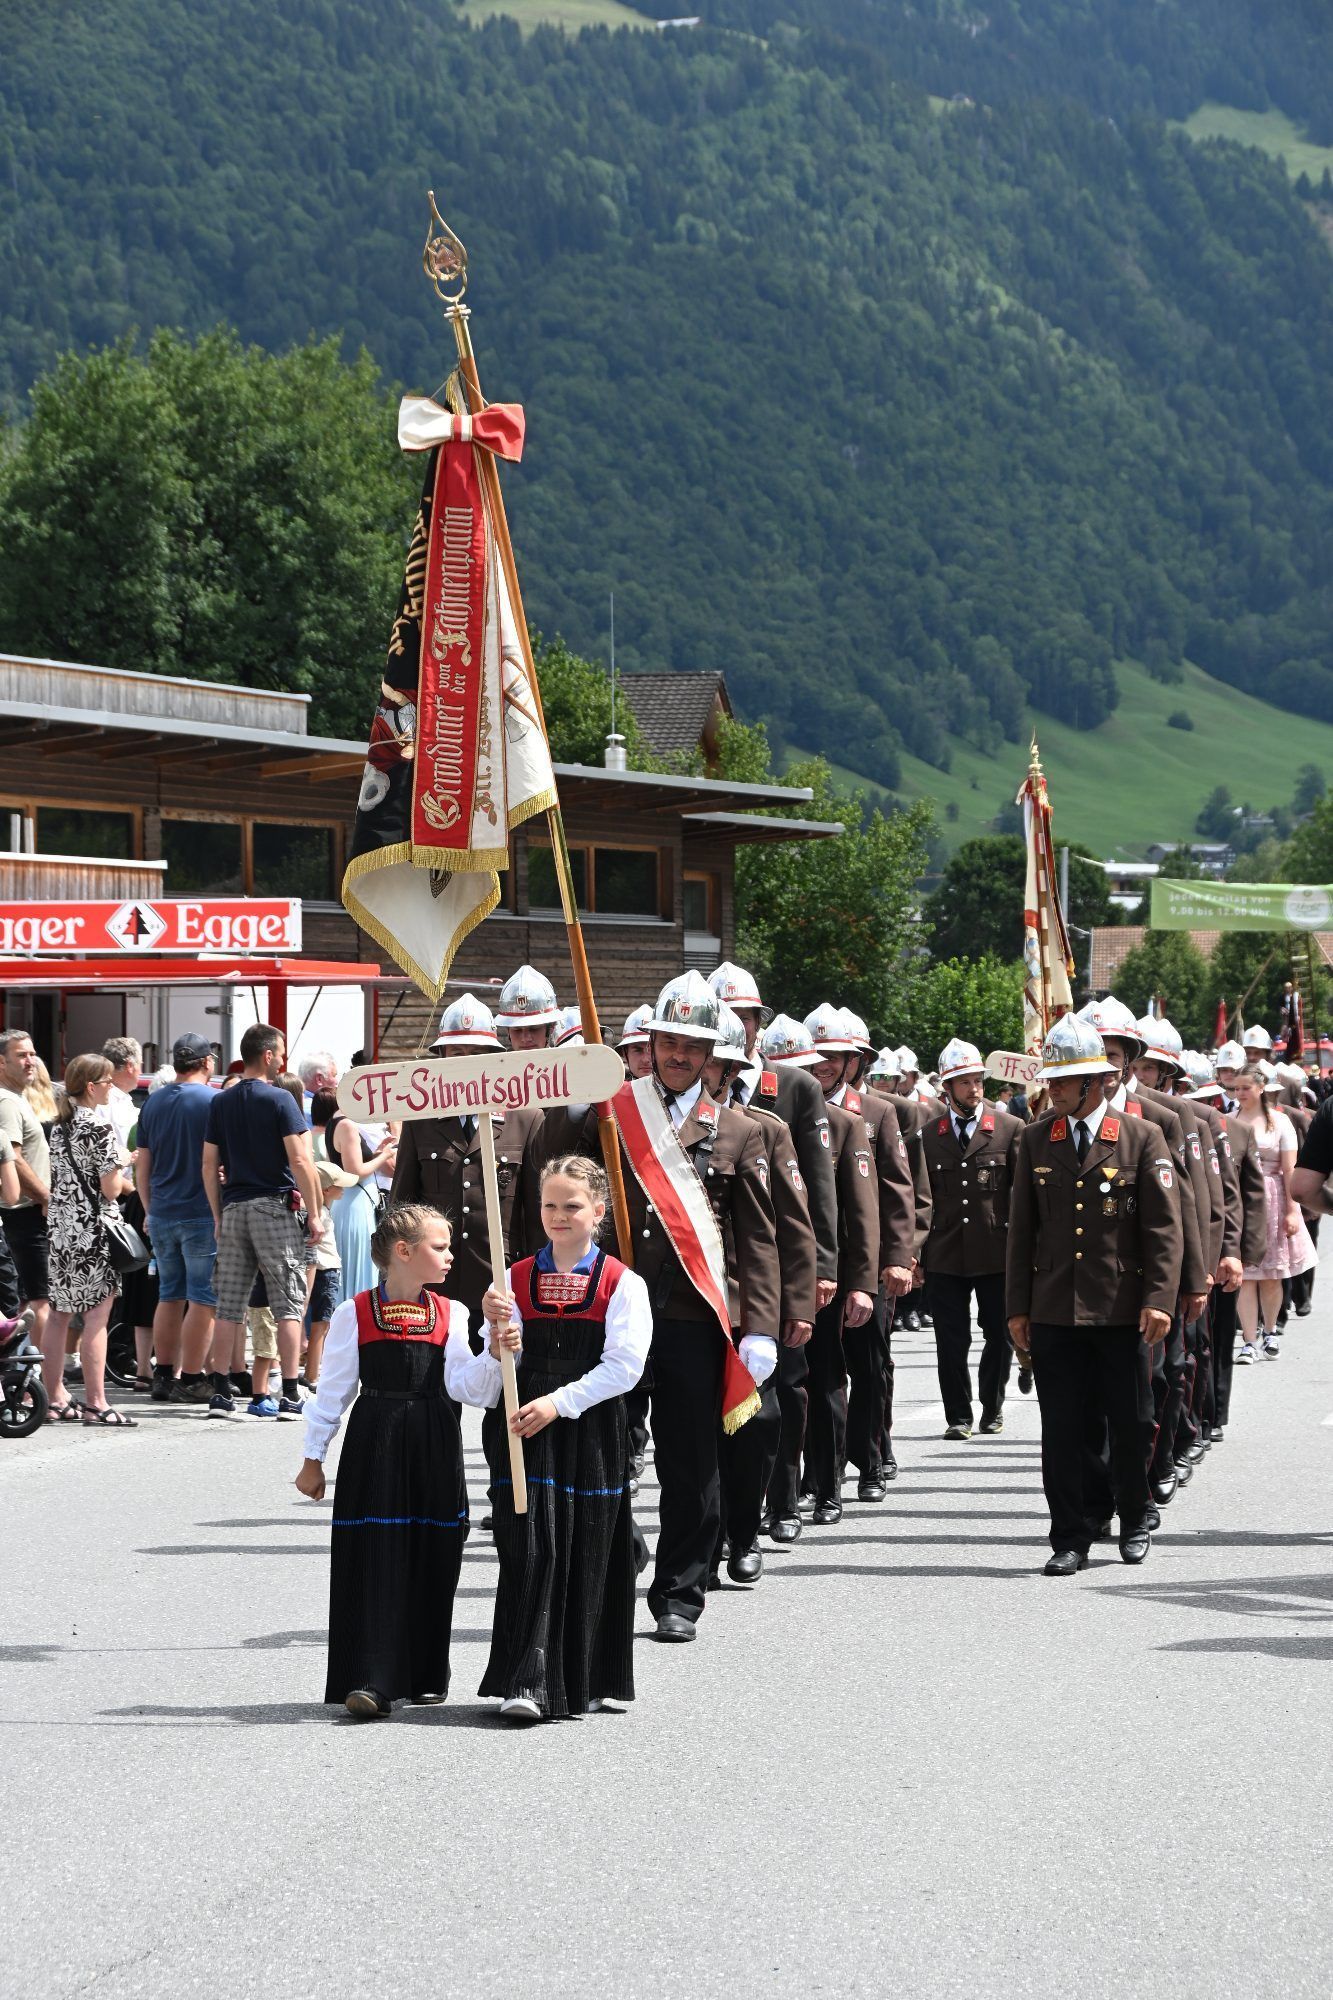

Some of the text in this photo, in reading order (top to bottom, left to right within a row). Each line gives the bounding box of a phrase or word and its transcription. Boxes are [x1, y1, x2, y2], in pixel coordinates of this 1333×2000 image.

[421, 507, 475, 829] Gewidmet von der Fahnenpatin
[1170, 906, 1271, 917] 9.00 bis 12.00 Uhr
[1251, 896, 1271, 904] von
[0, 916, 85, 949] gger
[352, 1062, 571, 1115] FF-Sibratsgfäll
